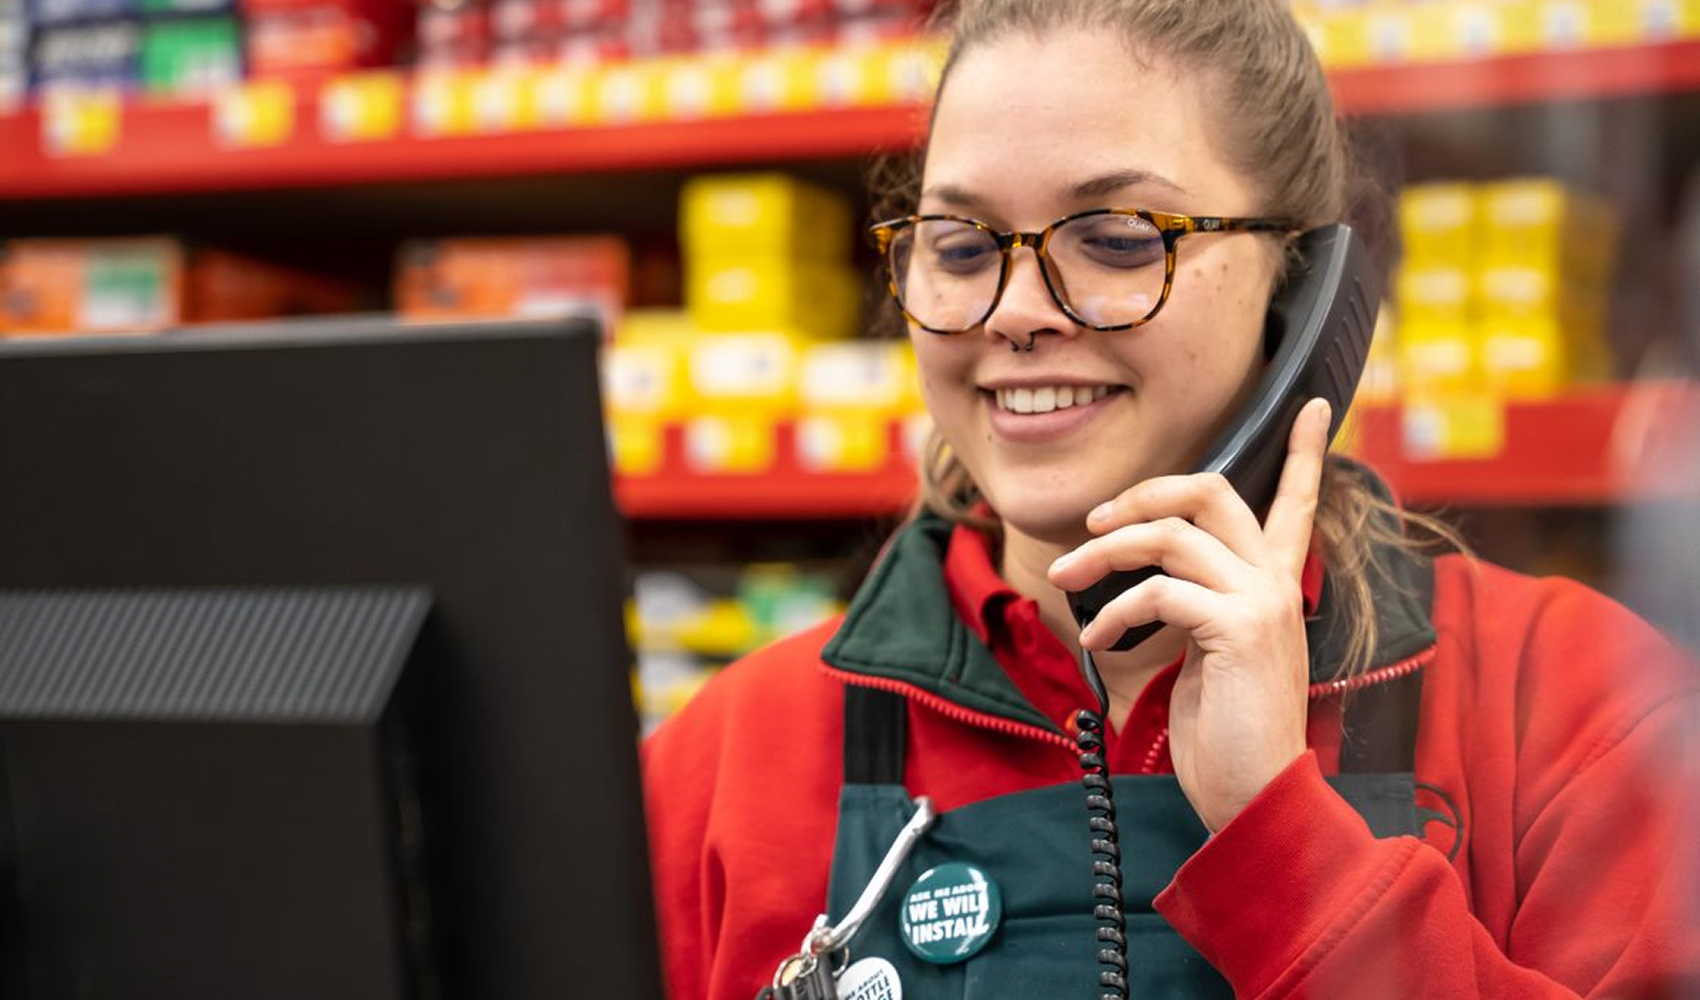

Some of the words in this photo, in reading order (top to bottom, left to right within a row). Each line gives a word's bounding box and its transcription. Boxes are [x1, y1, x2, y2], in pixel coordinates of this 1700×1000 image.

[1128, 218, 1150, 231] QUAY
[910, 891, 931, 902] ASK
[934, 887, 950, 898] ME
[909, 901, 938, 922] WE
